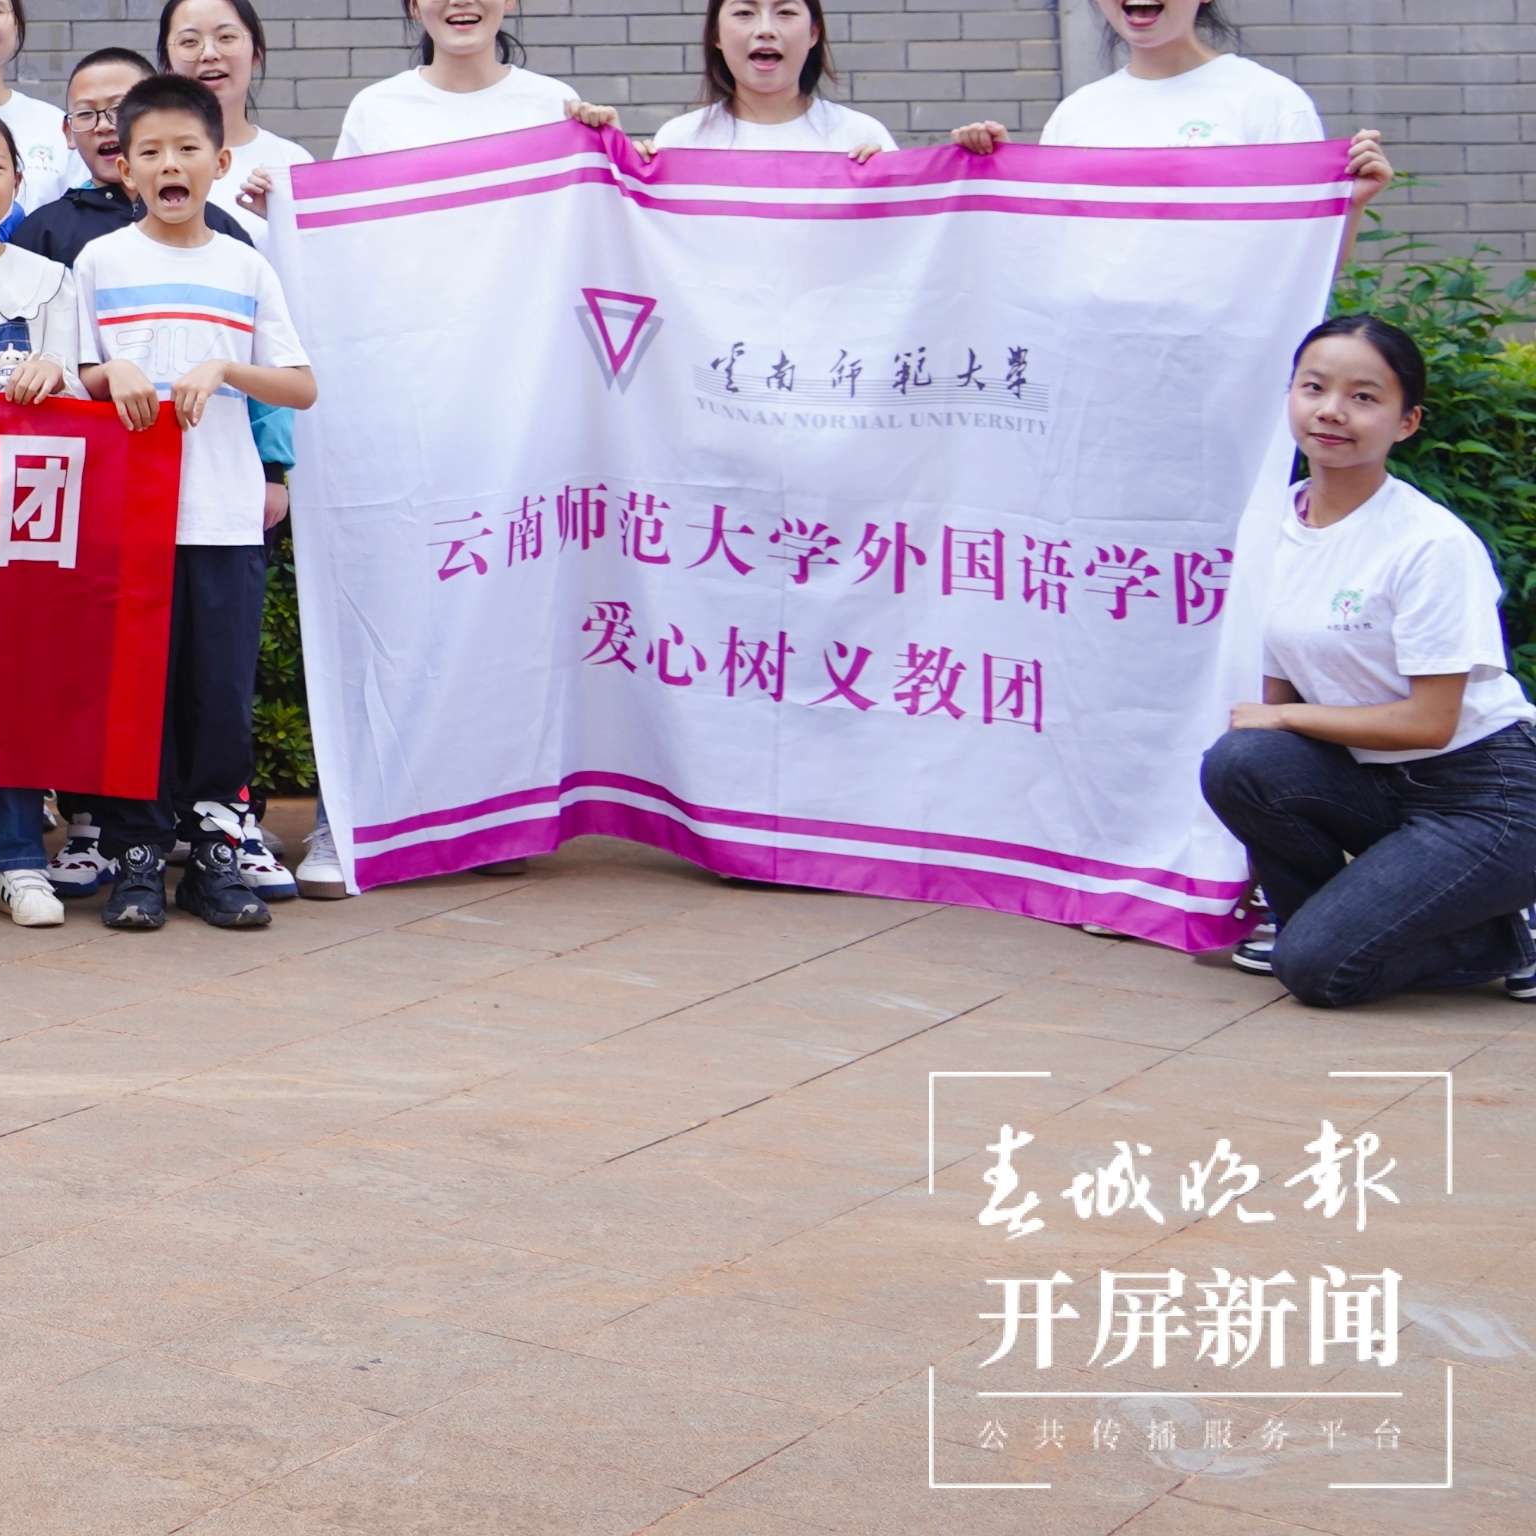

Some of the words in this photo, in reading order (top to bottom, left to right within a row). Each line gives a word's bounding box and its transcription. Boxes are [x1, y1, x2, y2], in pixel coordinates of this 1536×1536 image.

[696, 395, 788, 428] YUNNAN
[792, 411, 903, 430] NORMAL
[909, 410, 1050, 436] UNIVERSITY
[426, 484, 1233, 628] 云南师范大学外国语学院
[581, 601, 1044, 733] 爱心树义教团
